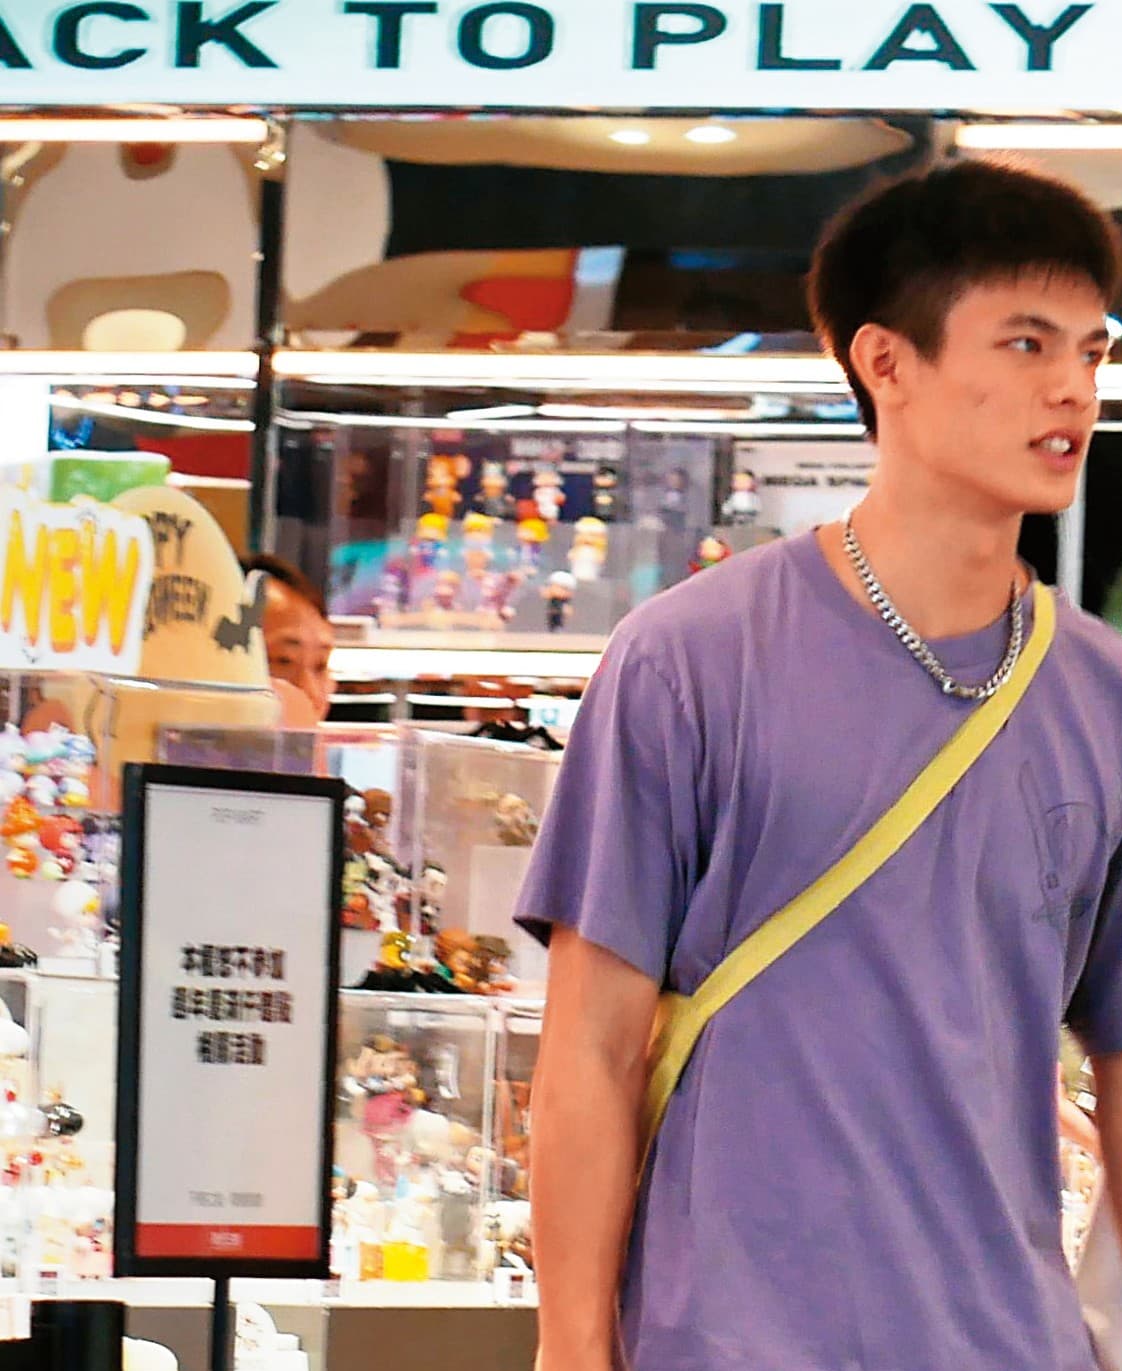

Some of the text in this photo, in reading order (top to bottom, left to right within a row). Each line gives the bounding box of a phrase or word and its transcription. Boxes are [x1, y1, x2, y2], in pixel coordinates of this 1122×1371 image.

[343, 1, 555, 70] TO
[631, 2, 1094, 71] PLAY
[2, 508, 140, 656] NEW
